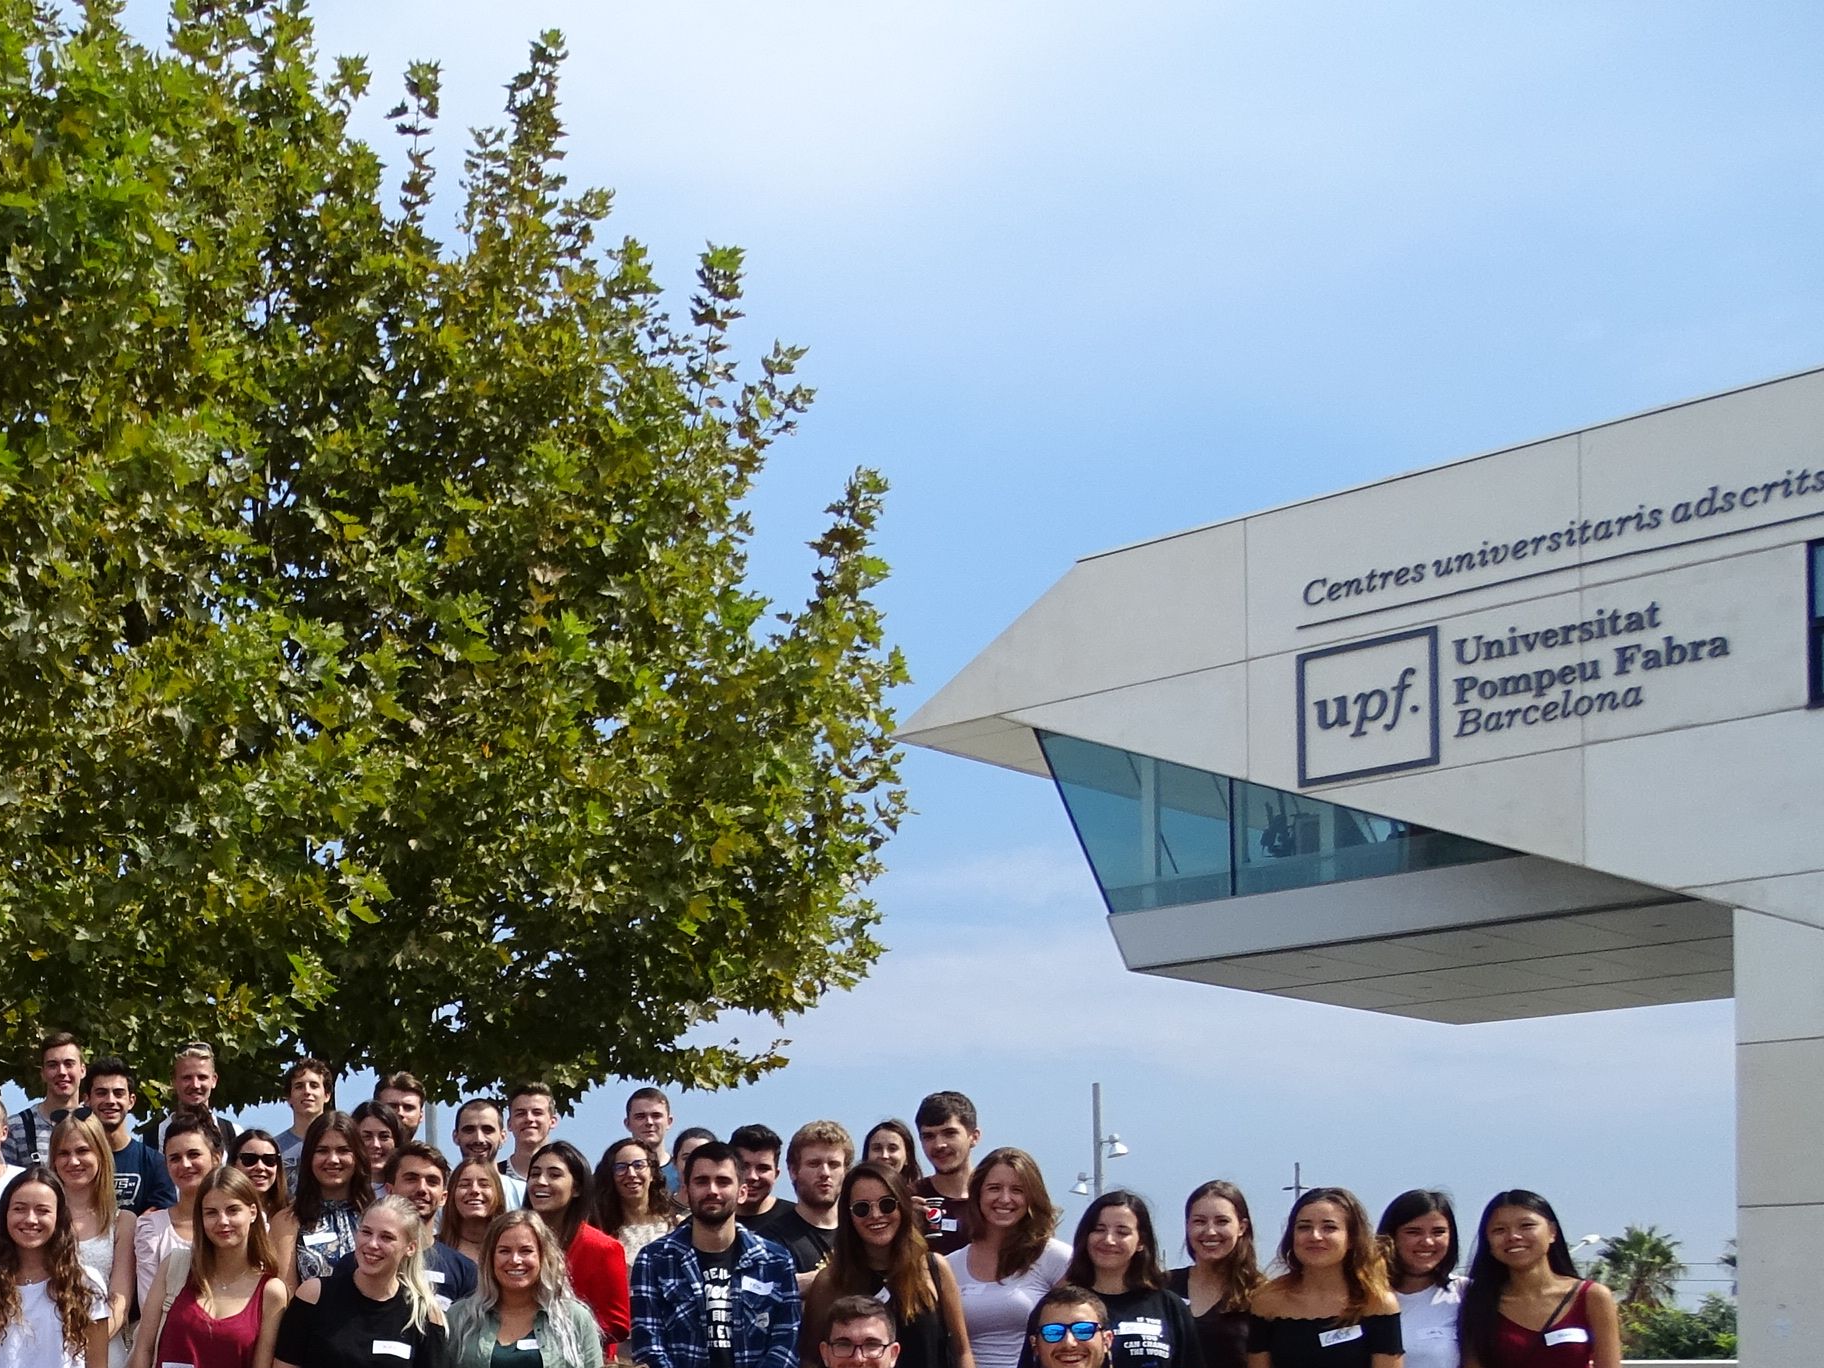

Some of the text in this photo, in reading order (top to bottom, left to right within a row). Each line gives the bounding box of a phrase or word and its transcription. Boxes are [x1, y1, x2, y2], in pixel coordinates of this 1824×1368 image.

[1302, 468, 1824, 606] Centres universitaris adscrits
[1452, 601, 1662, 665] Universitat
[1312, 667, 1420, 738] upf.
[1452, 633, 1730, 705] Pompeu Fabra
[1453, 683, 1644, 738] Barcelona
